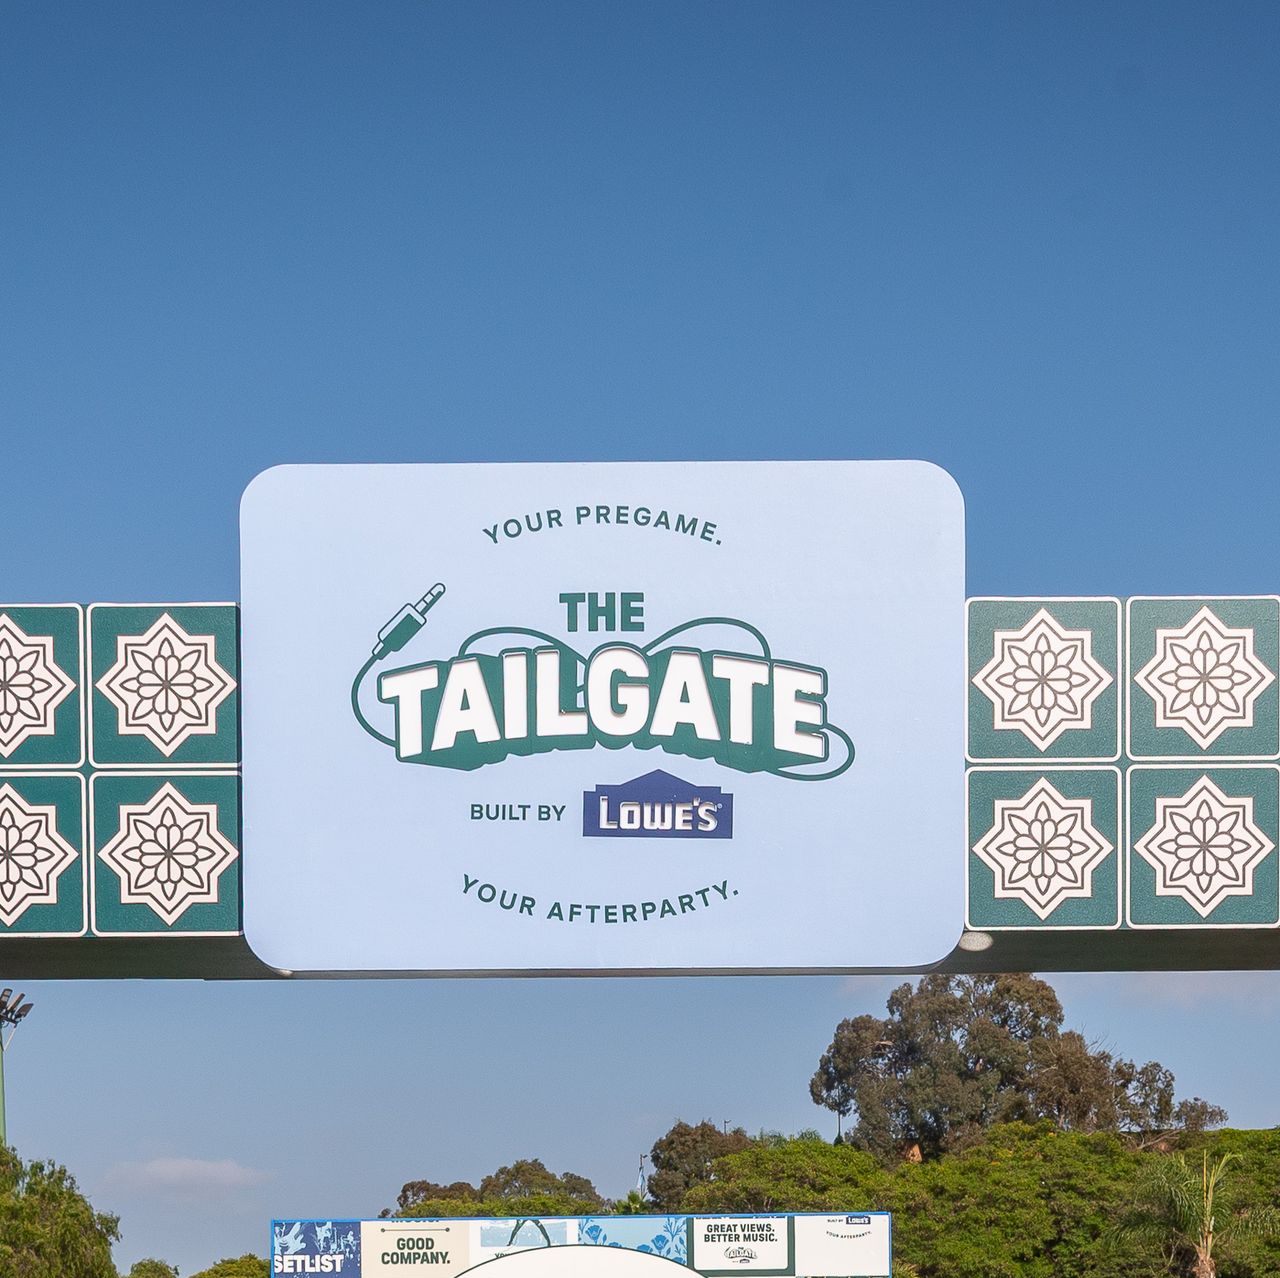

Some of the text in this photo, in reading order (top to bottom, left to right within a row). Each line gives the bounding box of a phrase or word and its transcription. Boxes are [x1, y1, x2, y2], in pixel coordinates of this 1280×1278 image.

[483, 505, 723, 546] YOUR PREGAME.
[559, 592, 645, 632] THE
[376, 641, 830, 769] TAILGATE
[470, 804, 531, 821] BUILT
[539, 804, 566, 821] BY
[462, 873, 739, 924] YOUR AFTERPARTY.
[706, 1223, 775, 1233] GREAT VIEWS.
[397, 1237, 435, 1250] GOOD
[704, 1233, 778, 1242] BETTER MUSIC.
[381, 1251, 451, 1265] COMPANY.
